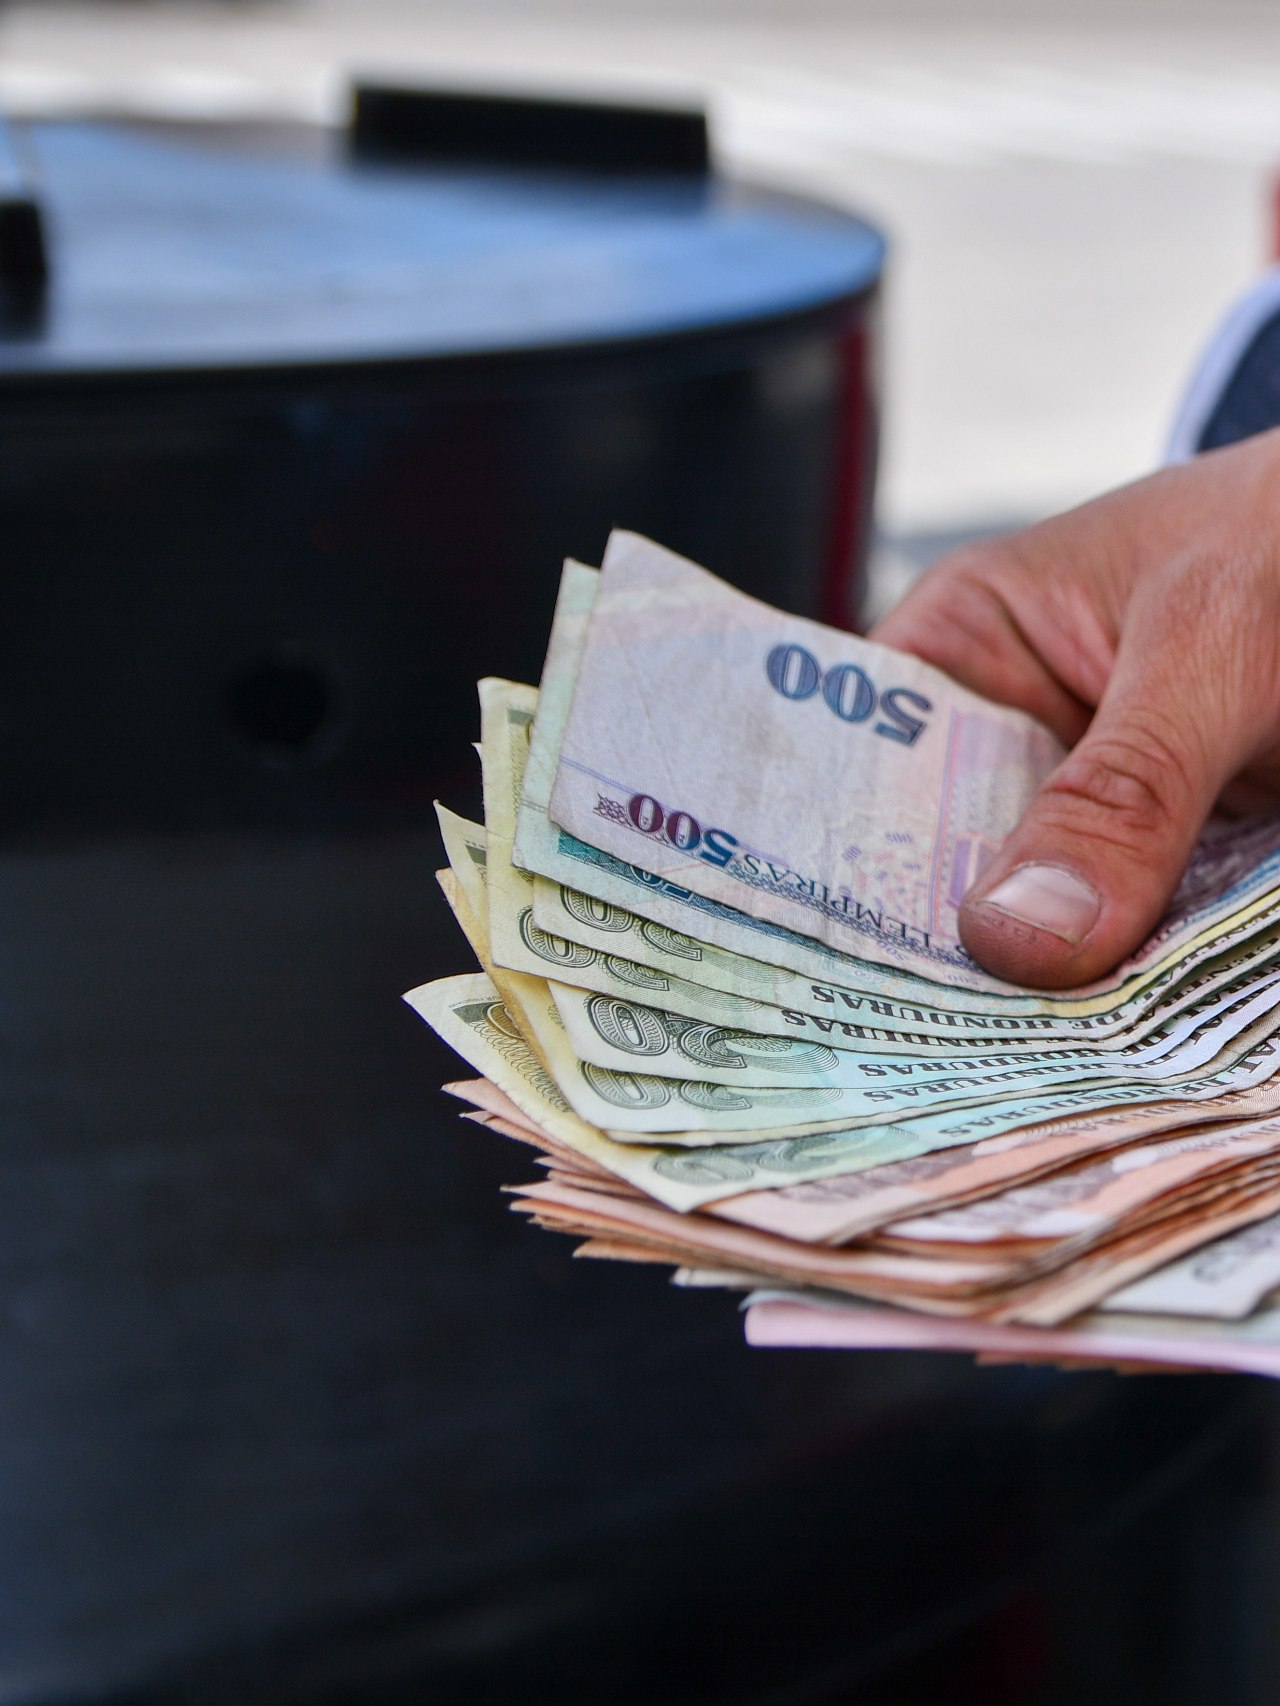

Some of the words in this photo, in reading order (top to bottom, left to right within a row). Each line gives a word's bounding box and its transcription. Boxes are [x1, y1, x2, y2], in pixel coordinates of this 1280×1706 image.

[765, 643, 933, 748] 500
[627, 794, 739, 868] 500
[744, 854, 932, 949] LEMPIRAS
[586, 991, 748, 1070] 20
[811, 985, 1057, 1032] HONDURAS
[857, 1049, 1106, 1078] HONDURAS
[862, 1063, 1108, 1103] HONDURAS
[939, 1087, 1169, 1139] HONDURAS
